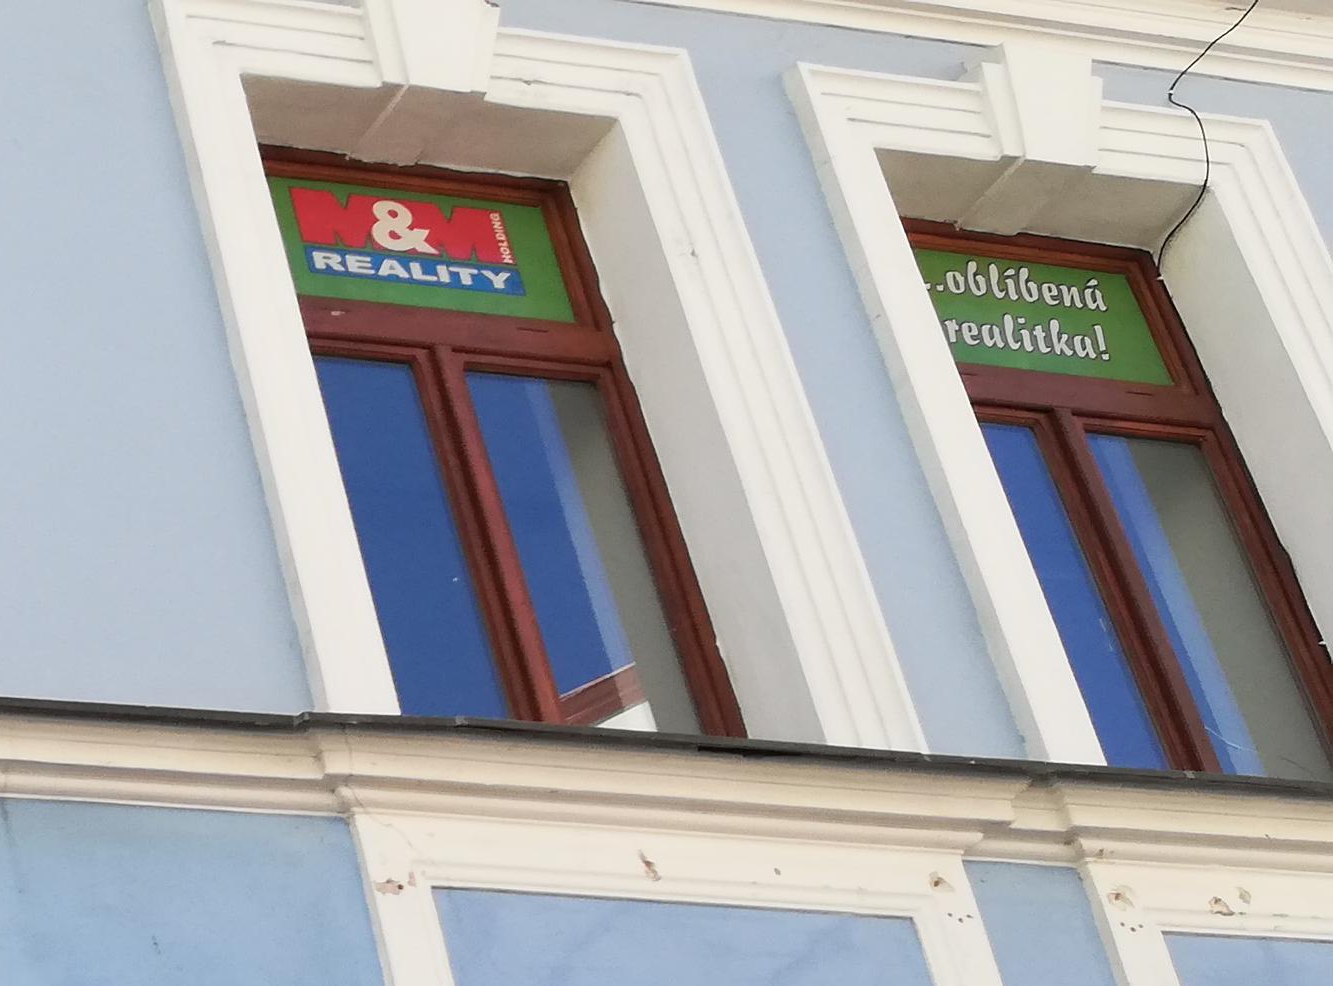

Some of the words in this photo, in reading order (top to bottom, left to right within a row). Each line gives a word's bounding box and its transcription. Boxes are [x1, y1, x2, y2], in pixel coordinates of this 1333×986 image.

[288, 185, 518, 266] M&M
[489, 212, 515, 265] HOLDING
[311, 250, 512, 290] REALITY
[924, 260, 1109, 312] ..oblíbená
[943, 313, 1111, 361] realitka!
